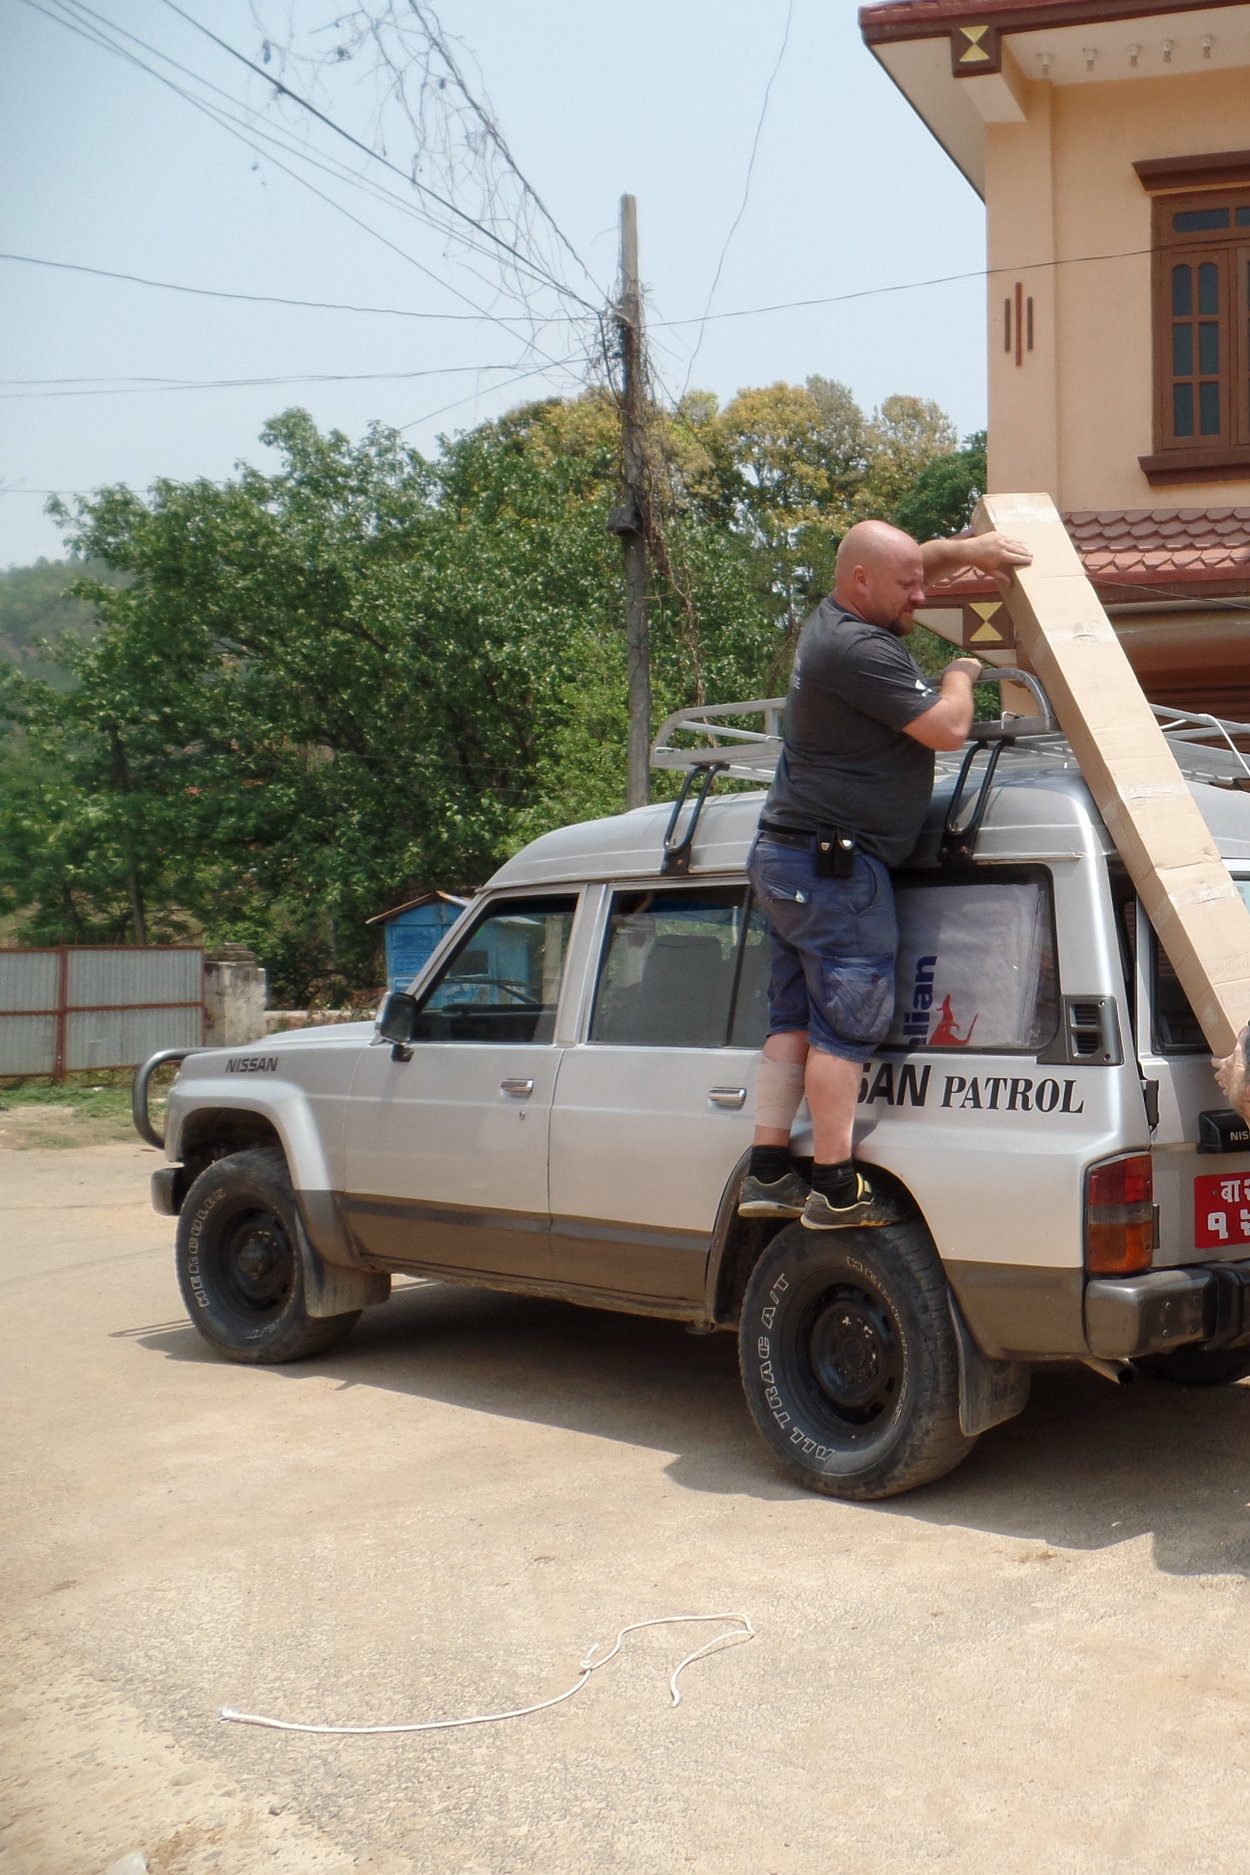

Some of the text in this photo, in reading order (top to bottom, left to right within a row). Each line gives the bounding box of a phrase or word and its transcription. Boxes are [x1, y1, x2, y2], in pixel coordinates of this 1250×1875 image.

[225, 1056, 279, 1073] NISSAN
[940, 1075, 1084, 1114] PATROL
[758, 1336, 791, 1429] TRAC
[789, 1426, 835, 1461] ALL
